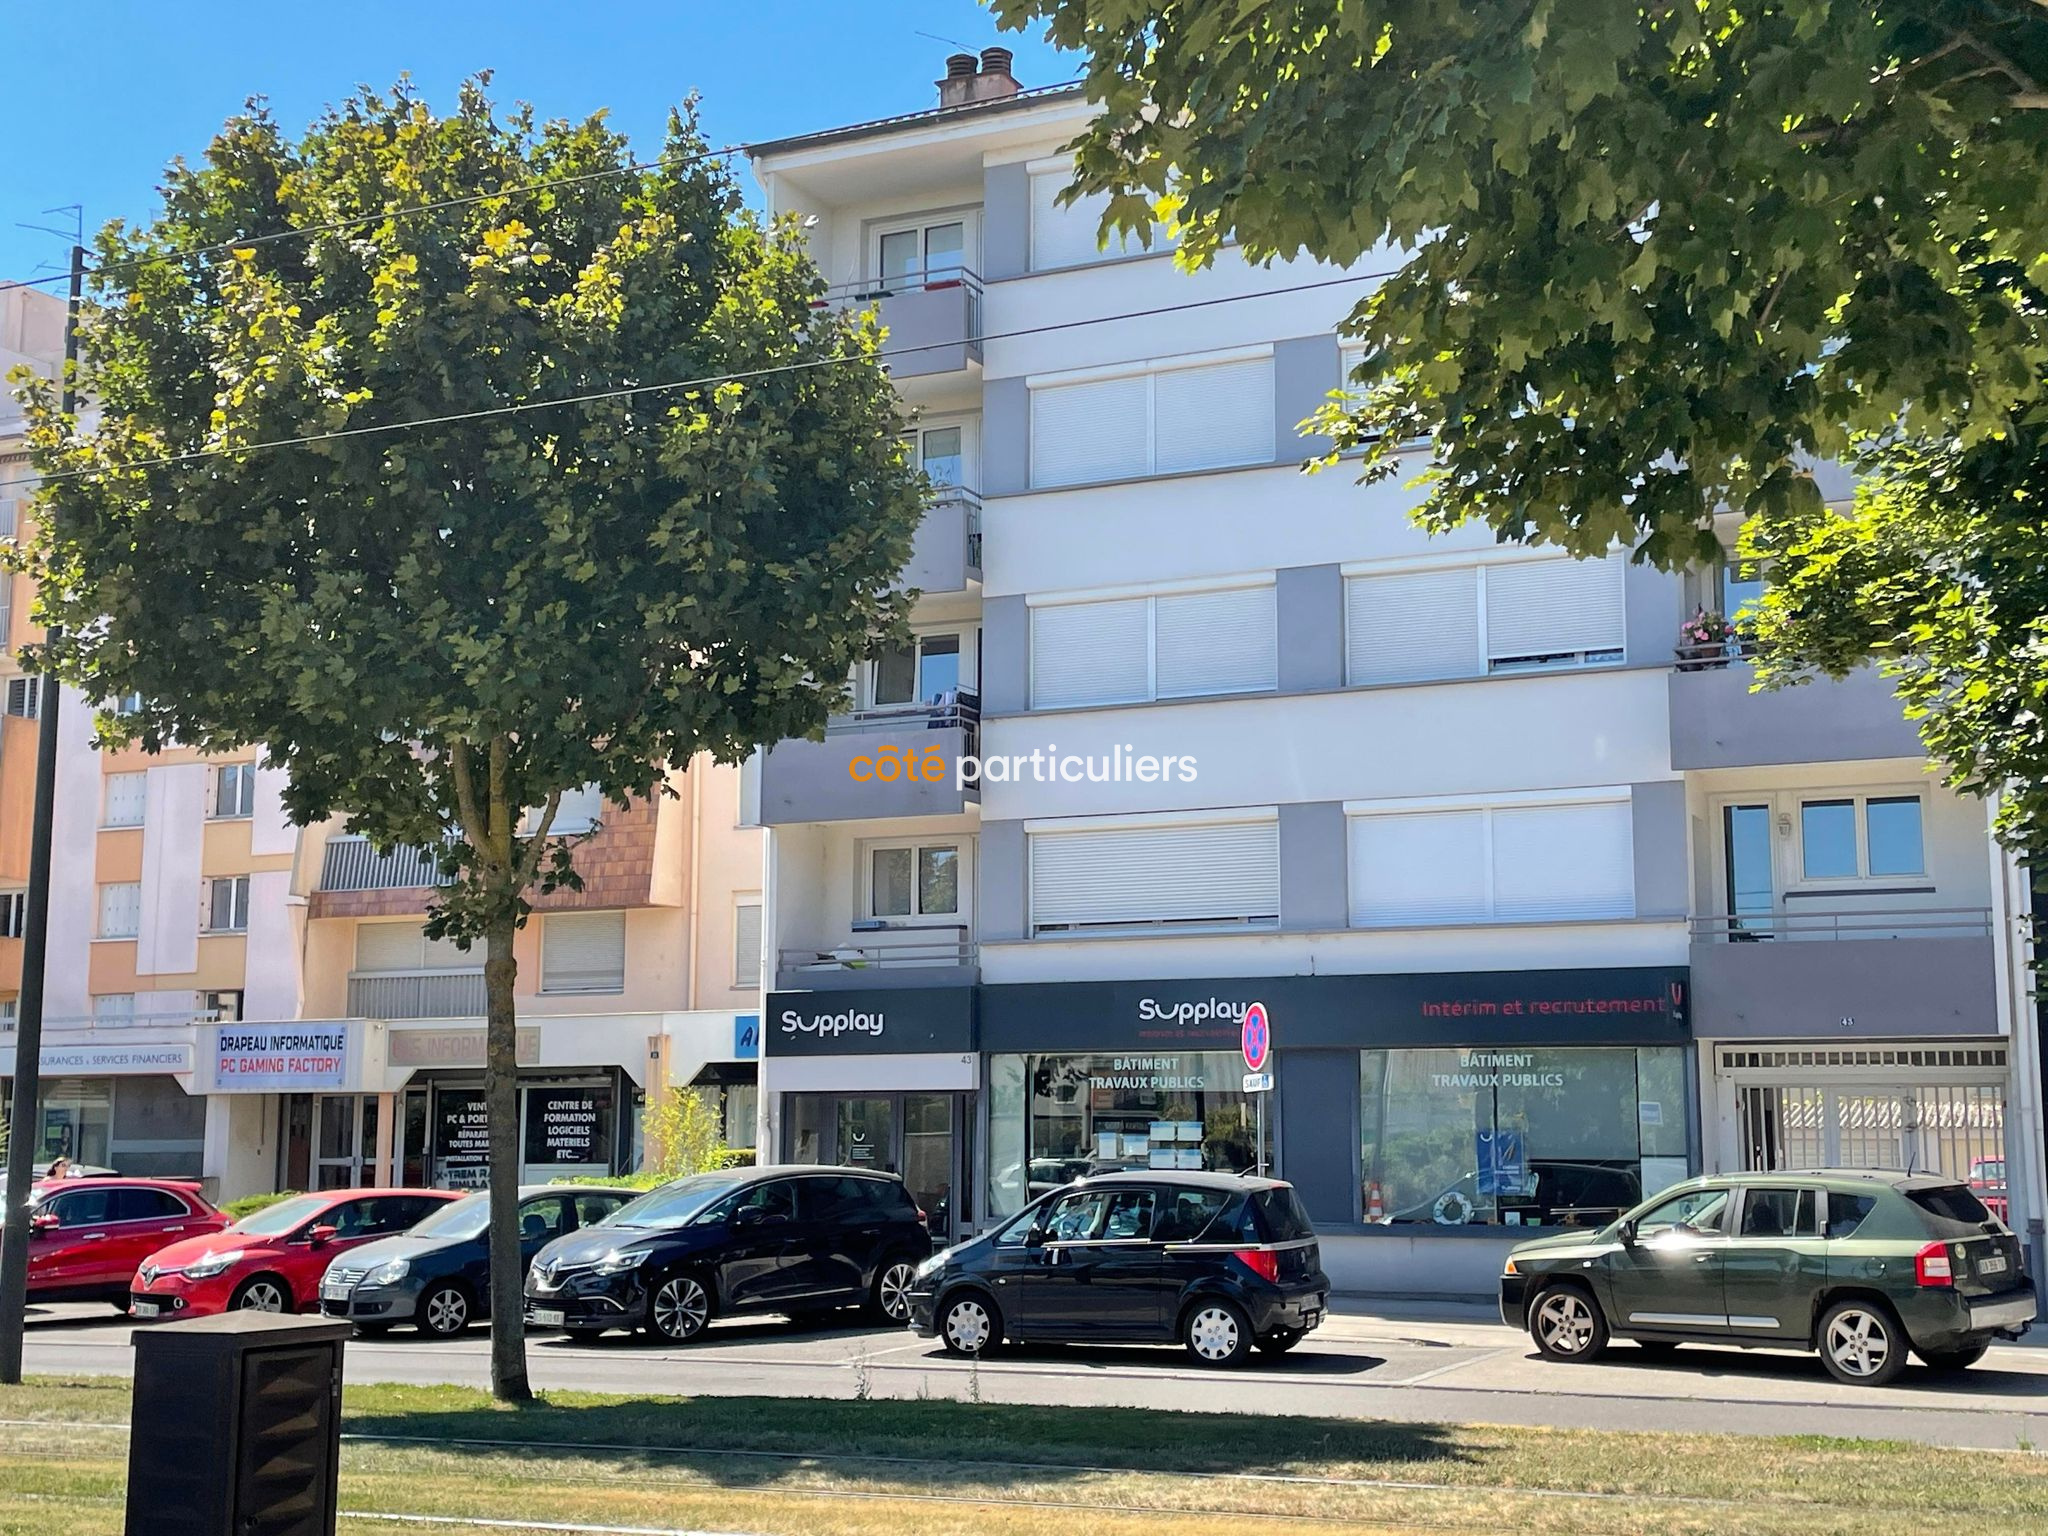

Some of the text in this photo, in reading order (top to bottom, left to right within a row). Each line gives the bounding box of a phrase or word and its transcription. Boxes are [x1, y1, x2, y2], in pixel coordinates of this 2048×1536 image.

[1139, 997, 1247, 1025] Supplay
[1503, 1000, 1524, 1015] et
[1529, 998, 1667, 1014] recrutement
[781, 1008, 884, 1037] Supplay
[220, 1035, 344, 1052] DRAPEAU INFORMATIQUE
[39, 1055, 84, 1067] SURANCES
[92, 1054, 129, 1065] SERVICES
[131, 1053, 182, 1064] FINANCIERS
[220, 1057, 341, 1073] PC GAMING FACTORY
[960, 1055, 973, 1065] 43
[1089, 1075, 1205, 1090] TRAVAUX PUBLICS
[1432, 1072, 1564, 1088] TRAVAUX PUBLICS
[467, 1102, 488, 1112] VENT
[547, 1100, 593, 1110] CENTRE DE
[446, 1114, 488, 1124] PC & PORT
[543, 1113, 596, 1123] FORMATION
[458, 1130, 489, 1138] RÉPARATI
[547, 1125, 590, 1135] LOGICIELS
[449, 1139, 490, 1148] TOUTES MAR
[448, 1180, 490, 1190] SIMULA
